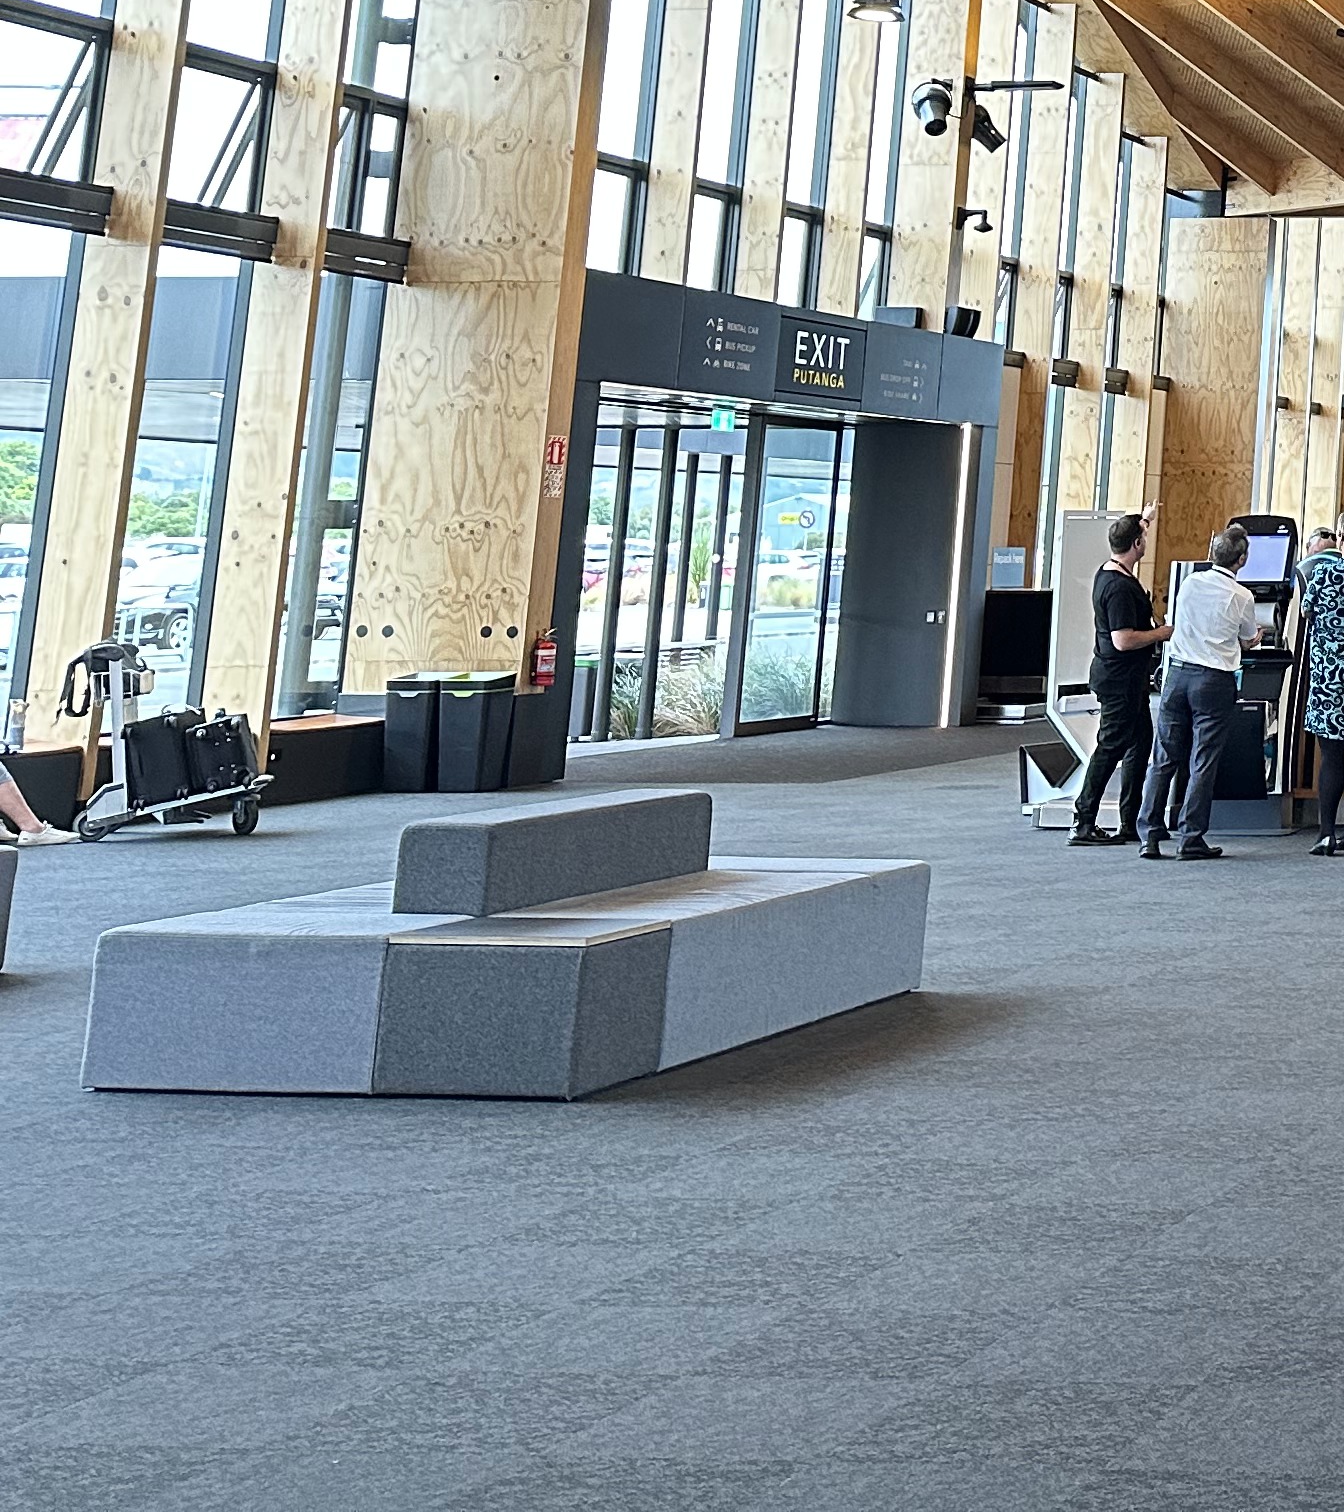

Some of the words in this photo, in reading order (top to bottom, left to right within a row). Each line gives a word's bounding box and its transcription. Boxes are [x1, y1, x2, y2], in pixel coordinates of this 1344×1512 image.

[748, 325, 760, 335] CAR
[794, 330, 850, 370] EXIT
[792, 368, 845, 389] PUTANGA
